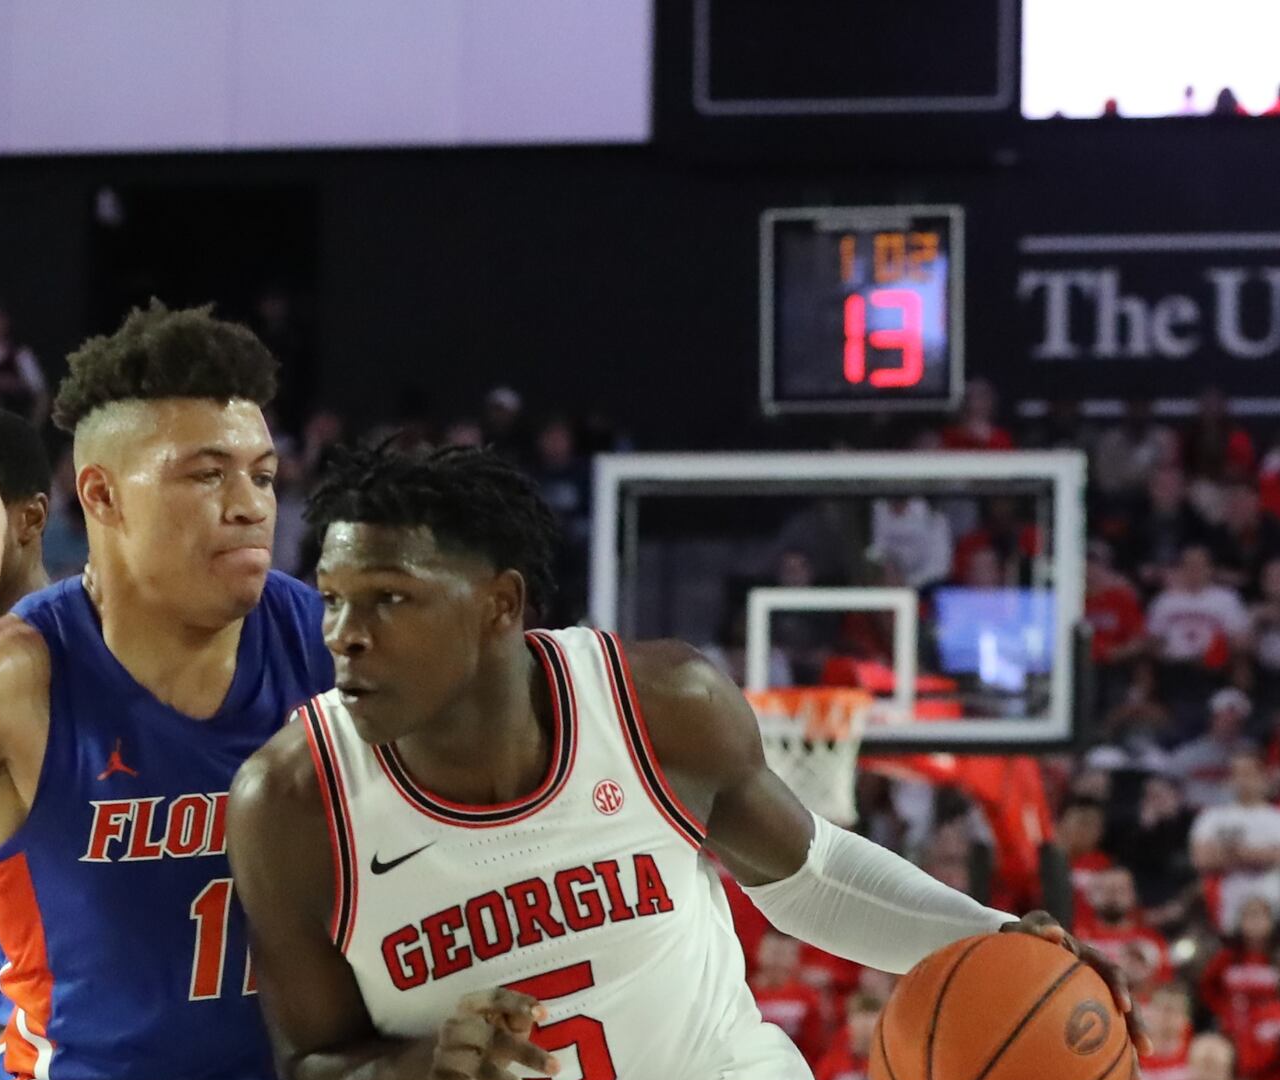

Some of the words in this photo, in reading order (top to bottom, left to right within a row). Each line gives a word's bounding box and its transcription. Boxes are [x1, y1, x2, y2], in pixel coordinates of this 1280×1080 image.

[842, 287, 924, 388] 13
[1017, 266, 1200, 358] The
[595, 783, 622, 812] SEC
[188, 877, 259, 1002] 1
[380, 853, 675, 992] GEORGIA
